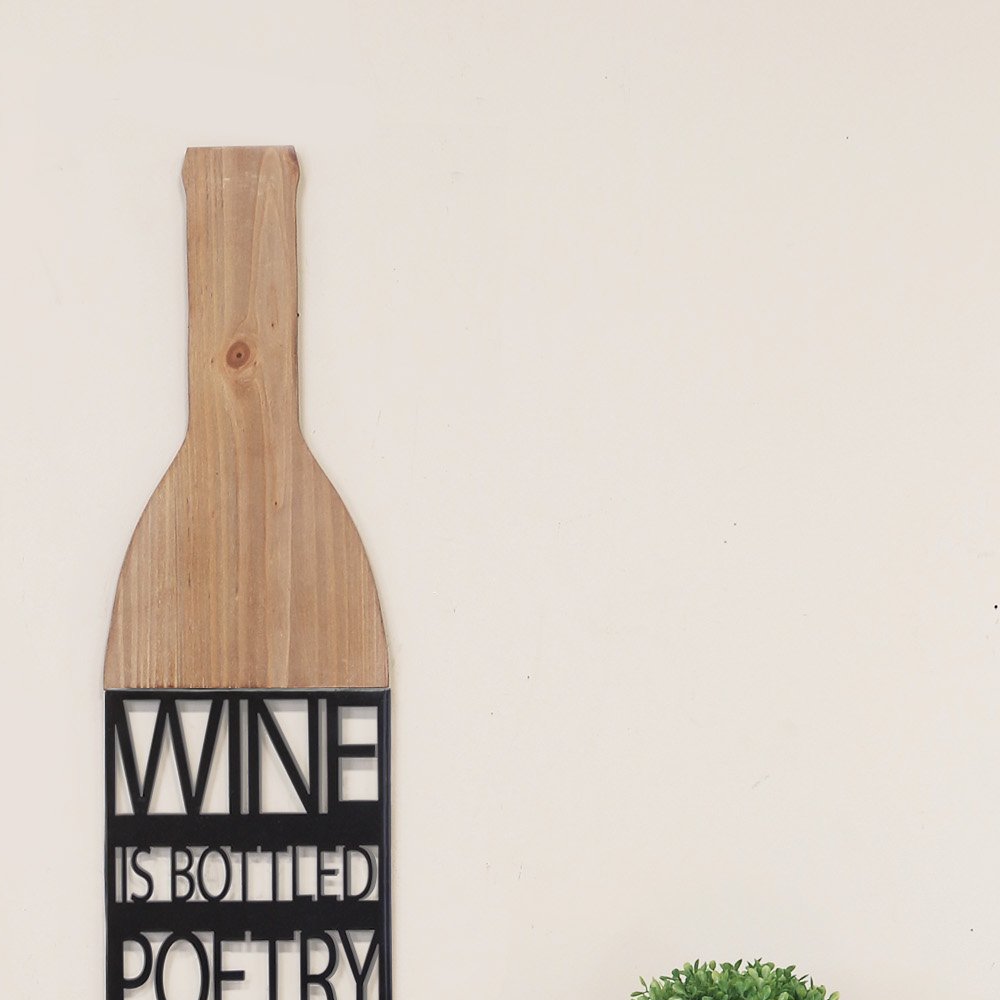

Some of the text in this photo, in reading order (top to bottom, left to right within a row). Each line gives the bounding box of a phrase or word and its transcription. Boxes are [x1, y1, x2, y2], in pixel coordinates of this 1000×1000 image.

[110, 698, 379, 815] WINE
[121, 845, 374, 902] IS BOTTLED
